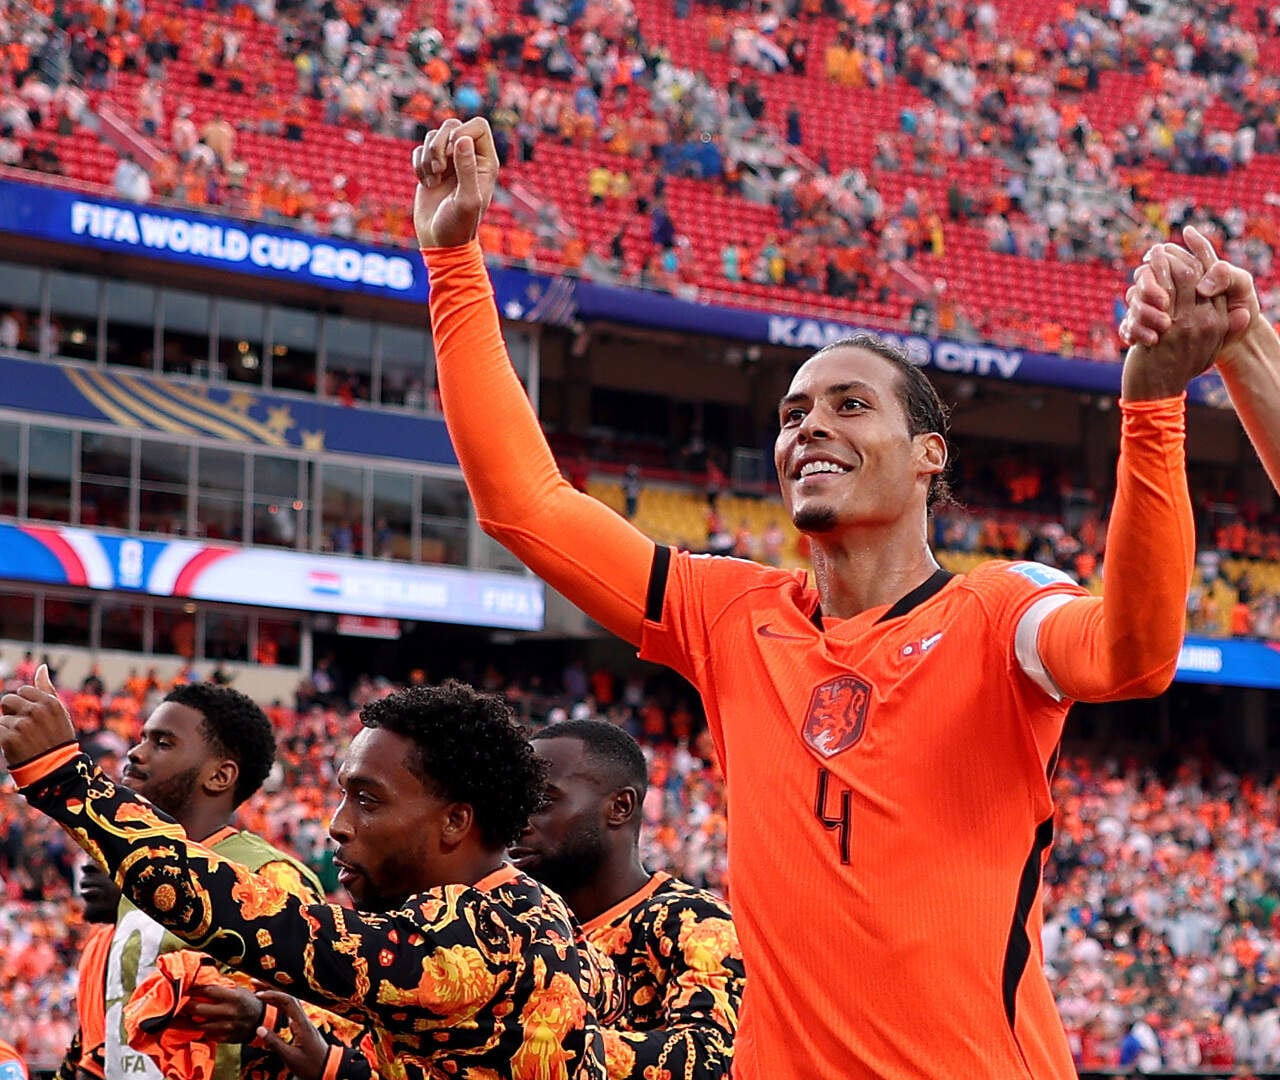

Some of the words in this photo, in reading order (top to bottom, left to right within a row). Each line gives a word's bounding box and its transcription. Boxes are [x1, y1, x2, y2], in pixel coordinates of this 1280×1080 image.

[71, 200, 140, 245] FIFA
[140, 213, 250, 262] WORLD
[250, 233, 311, 271] CUP
[310, 245, 414, 290] 2026
[935, 342, 1023, 379] CITY
[815, 767, 852, 866] 4
